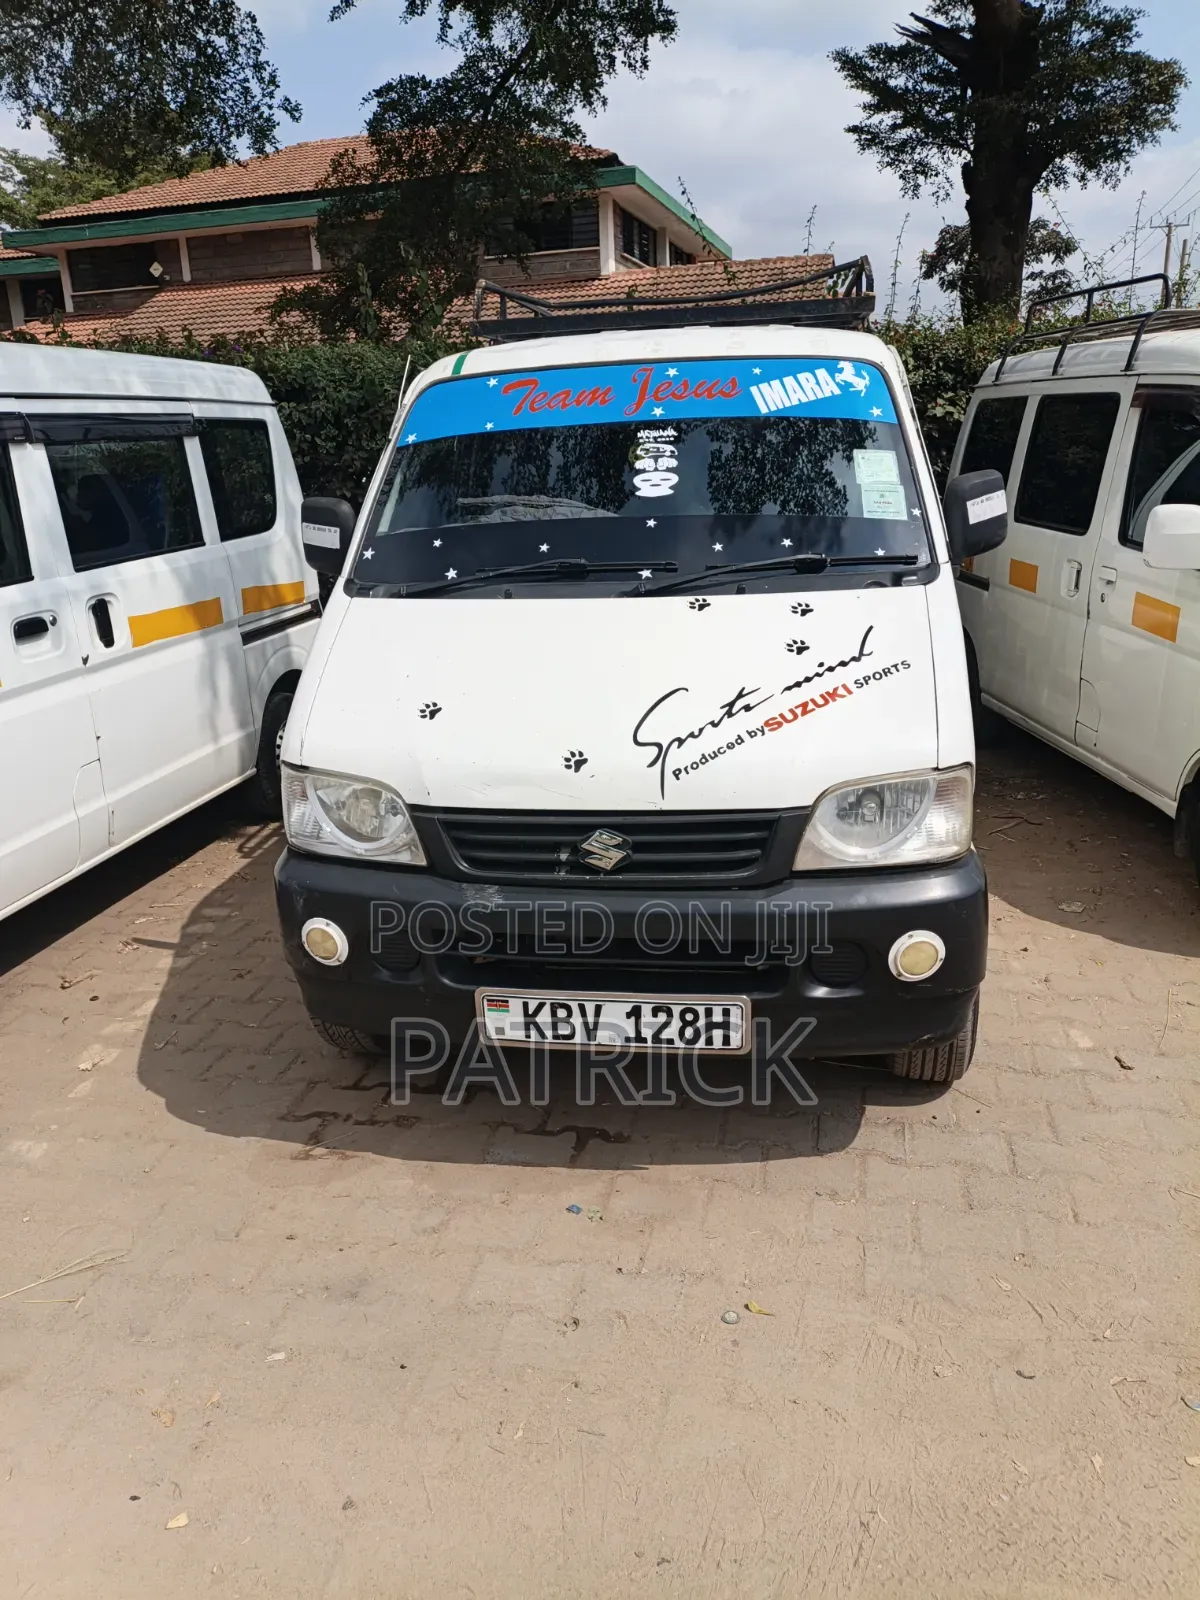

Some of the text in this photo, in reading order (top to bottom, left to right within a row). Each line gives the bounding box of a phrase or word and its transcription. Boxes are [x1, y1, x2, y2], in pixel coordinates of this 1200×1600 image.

[502, 366, 742, 416] Team Jesus
[750, 368, 842, 413] IMARA
[672, 660, 911, 781] Produced by SUZUKI SPORTS
[522, 1001, 605, 1042] KBV
[624, 1004, 731, 1047] 128H
